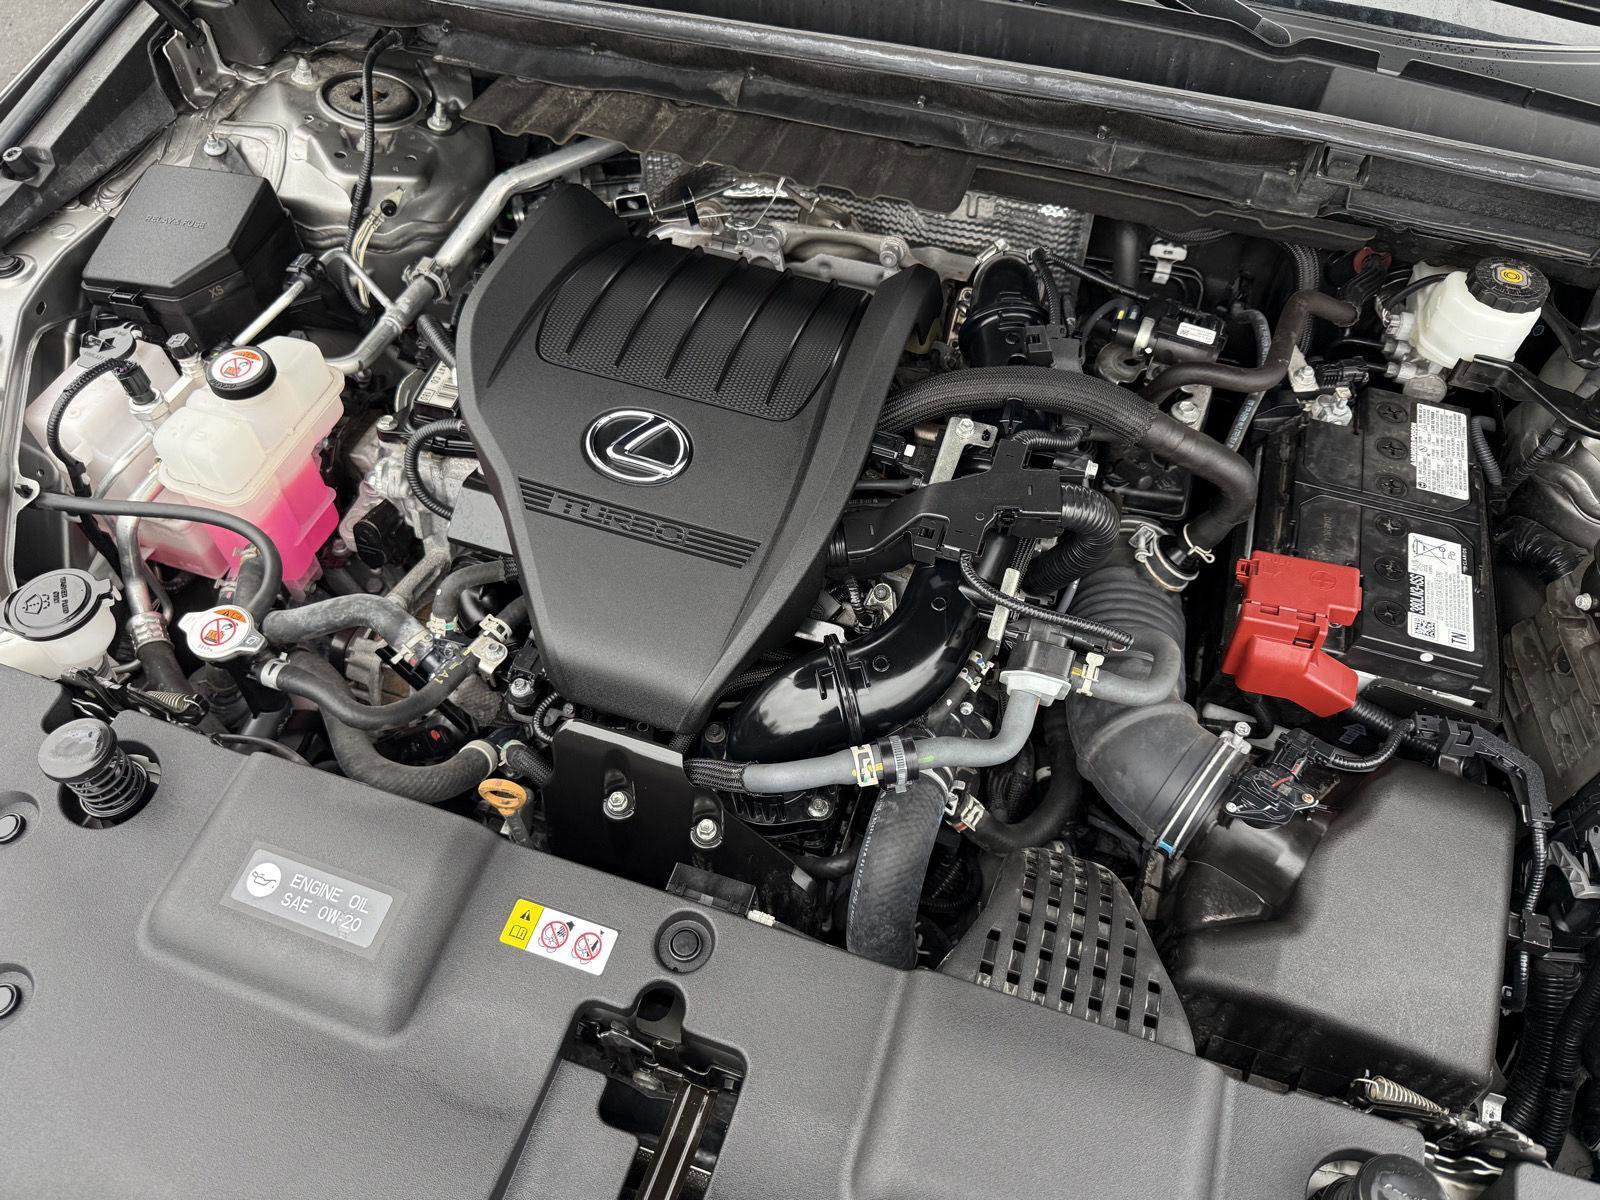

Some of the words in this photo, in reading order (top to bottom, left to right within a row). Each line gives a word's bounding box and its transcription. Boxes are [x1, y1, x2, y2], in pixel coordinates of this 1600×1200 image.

[208, 285, 224, 299] XS
[554, 494, 685, 543] TURBO
[1447, 551, 1456, 561] Pb
[1451, 631, 1467, 645] TN
[289, 873, 344, 903] ENGINE
[348, 894, 369, 914] OIL
[281, 892, 312, 914] SAE
[317, 905, 362, 932] 0W-20
